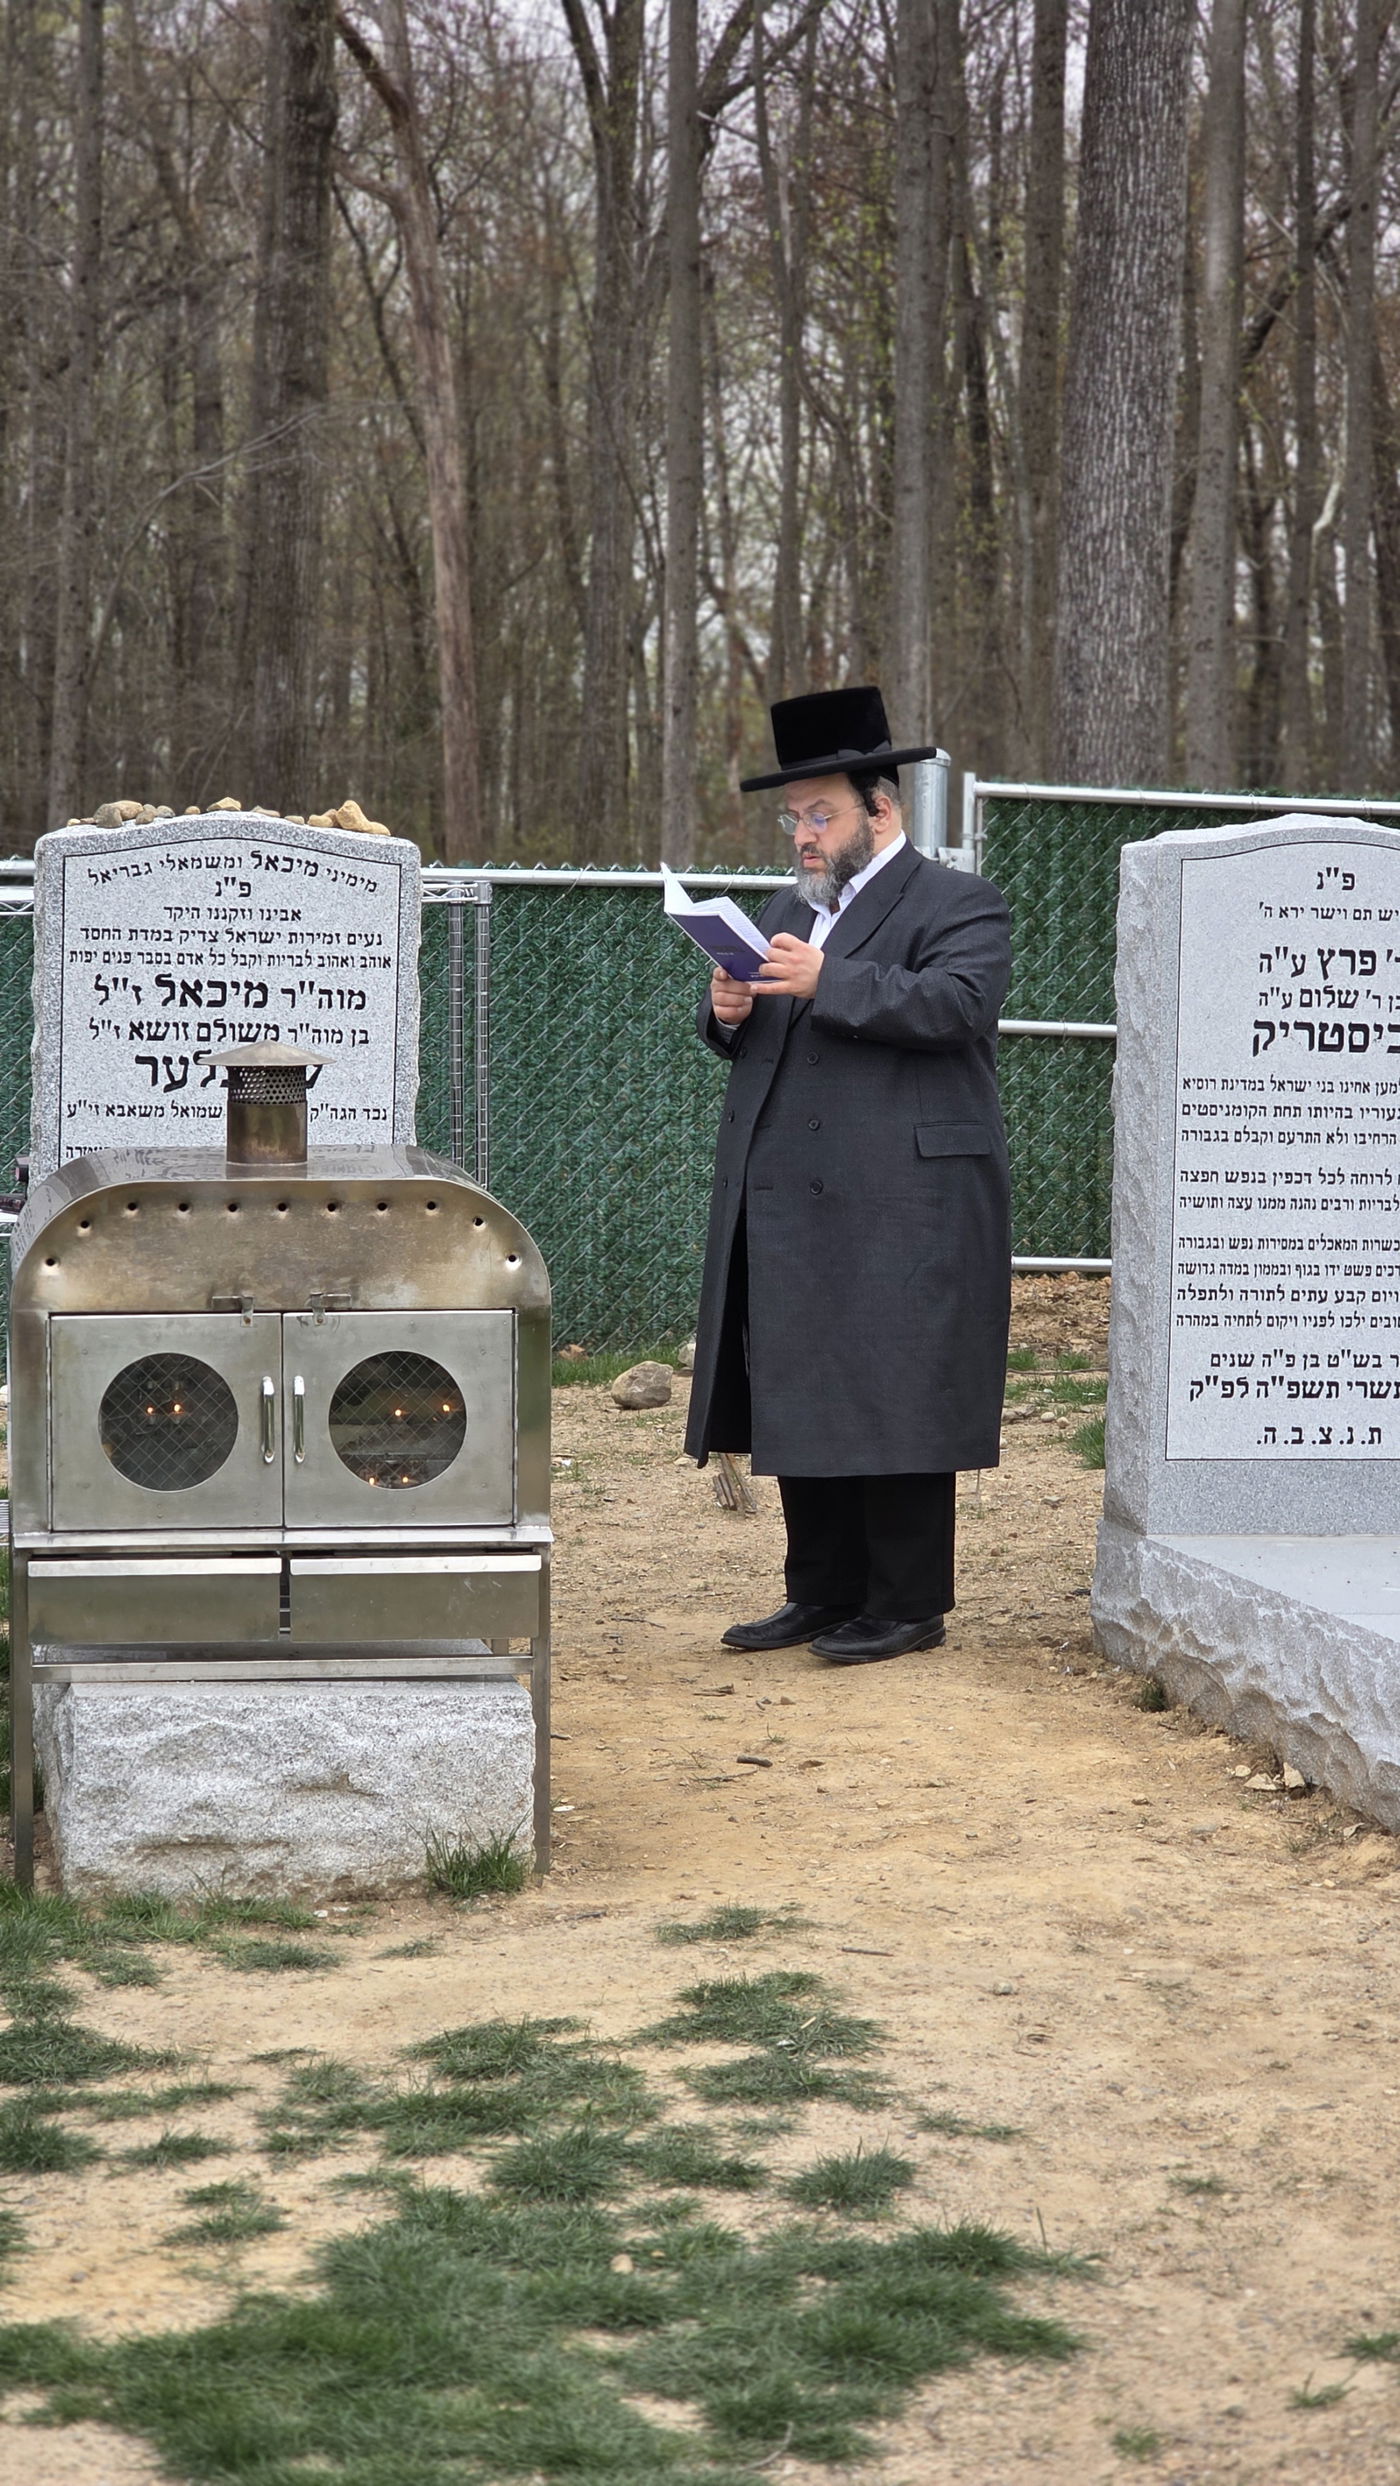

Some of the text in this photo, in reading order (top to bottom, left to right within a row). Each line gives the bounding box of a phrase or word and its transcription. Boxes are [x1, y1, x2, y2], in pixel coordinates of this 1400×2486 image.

[88, 850, 377, 893] מימיני מיכאל ומשמאלי גבריאל
[164, 907, 301, 923] אבינו וזקננו היקר
[1279, 907, 1304, 918] ירא
[1311, 908, 1347, 919] וישר
[1353, 909, 1372, 920] תם
[80, 928, 382, 947] נעים זמירות ישראל צדיק במדת החסד
[70, 950, 391, 968] אוהב ואהוב לבריות וקבל כל אדם בסבר פנים יפות
[1318, 948, 1376, 980] פרץ
[155, 974, 268, 1008] מיכאל
[1300, 985, 1359, 1008] שלום
[129, 1021, 188, 1040] זושא
[197, 1018, 279, 1042] משולם
[352, 1030, 369, 1047] בן
[1183, 1074, 1400, 1096] מען אחינו בני ישראל במדינת רוסיא
[171, 1100, 222, 1118] שמואל
[363, 1109, 386, 1120] נכד
[1182, 1104, 1266, 1119] הקומניסטים
[1274, 1106, 1301, 1117] תחת
[1308, 1107, 1352, 1118] בהיותו
[1182, 1128, 1396, 1145] הרחיבו ולא התרעם וקבלם בגבורה
[1181, 1171, 1218, 1182] חפצה
[1225, 1171, 1266, 1183] בנפש
[1273, 1172, 1312, 1186] דכפין
[1318, 1167, 1344, 1184] לכל
[1351, 1168, 1392, 1185] לרוחה
[1180, 1194, 1399, 1211] לבריות ורבים נהנה ממנו עצה ותושיה
[1179, 1238, 1224, 1248] ובגבורה
[1229, 1238, 1252, 1249] נפש
[1258, 1238, 1303, 1250] במסירות
[1308, 1234, 1357, 1250] המאכלים
[1178, 1263, 1214, 1274] גדושה
[1220, 1264, 1249, 1275] במדה
[1254, 1264, 1290, 1277] ובממון
[1296, 1264, 1320, 1278] בגוף
[1325, 1265, 1340, 1276] ידו
[1344, 1265, 1371, 1276] פשט
[1178, 1286, 1398, 1304] ויום קבע עתים לתורה ולתפלה
[1177, 1311, 1400, 1329] ובים ילכו לפניו ויקום לתחיה במהרה
[1211, 1354, 1254, 1367] שנים
[1303, 1354, 1320, 1370] בן
